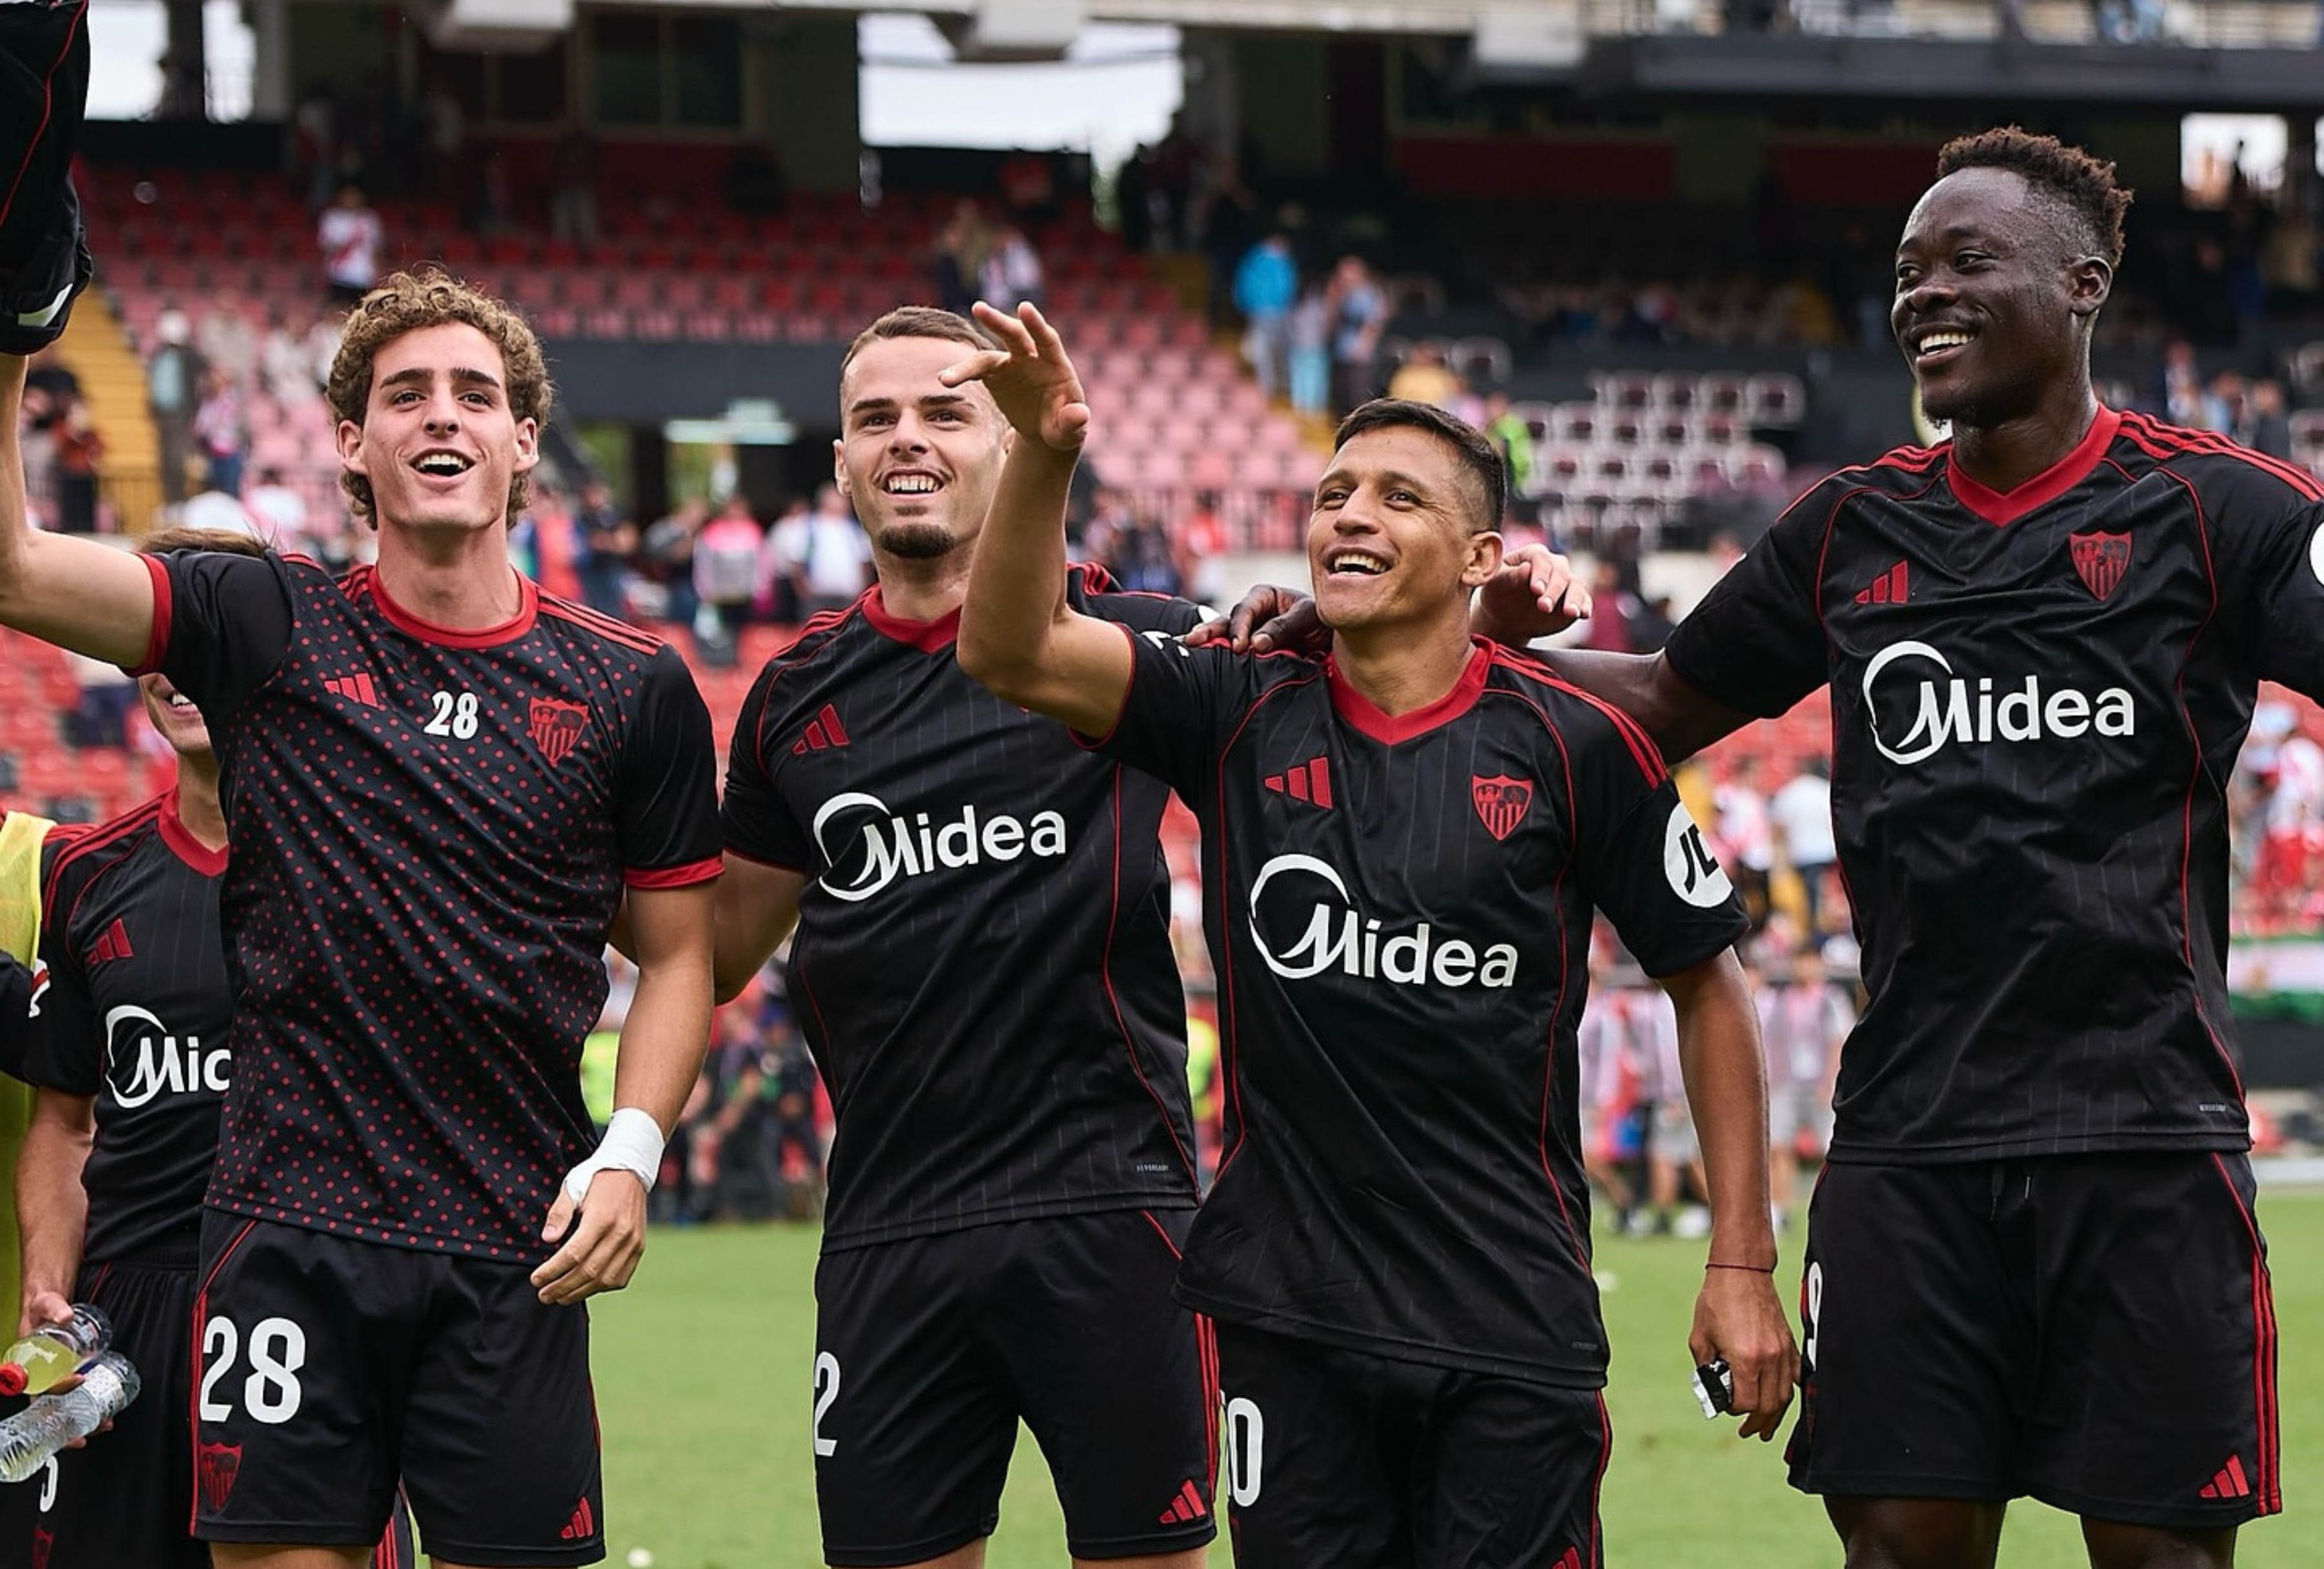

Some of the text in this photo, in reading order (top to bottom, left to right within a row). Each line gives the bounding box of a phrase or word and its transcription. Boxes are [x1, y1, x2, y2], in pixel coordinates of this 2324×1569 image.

[423, 691, 478, 740] 28
[1862, 641, 2135, 765] Midea
[813, 792, 1066, 902] Midea
[1249, 854, 1518, 988] Midea
[199, 1315, 307, 1424] 28
[1220, 1390, 1263, 1507] 0
